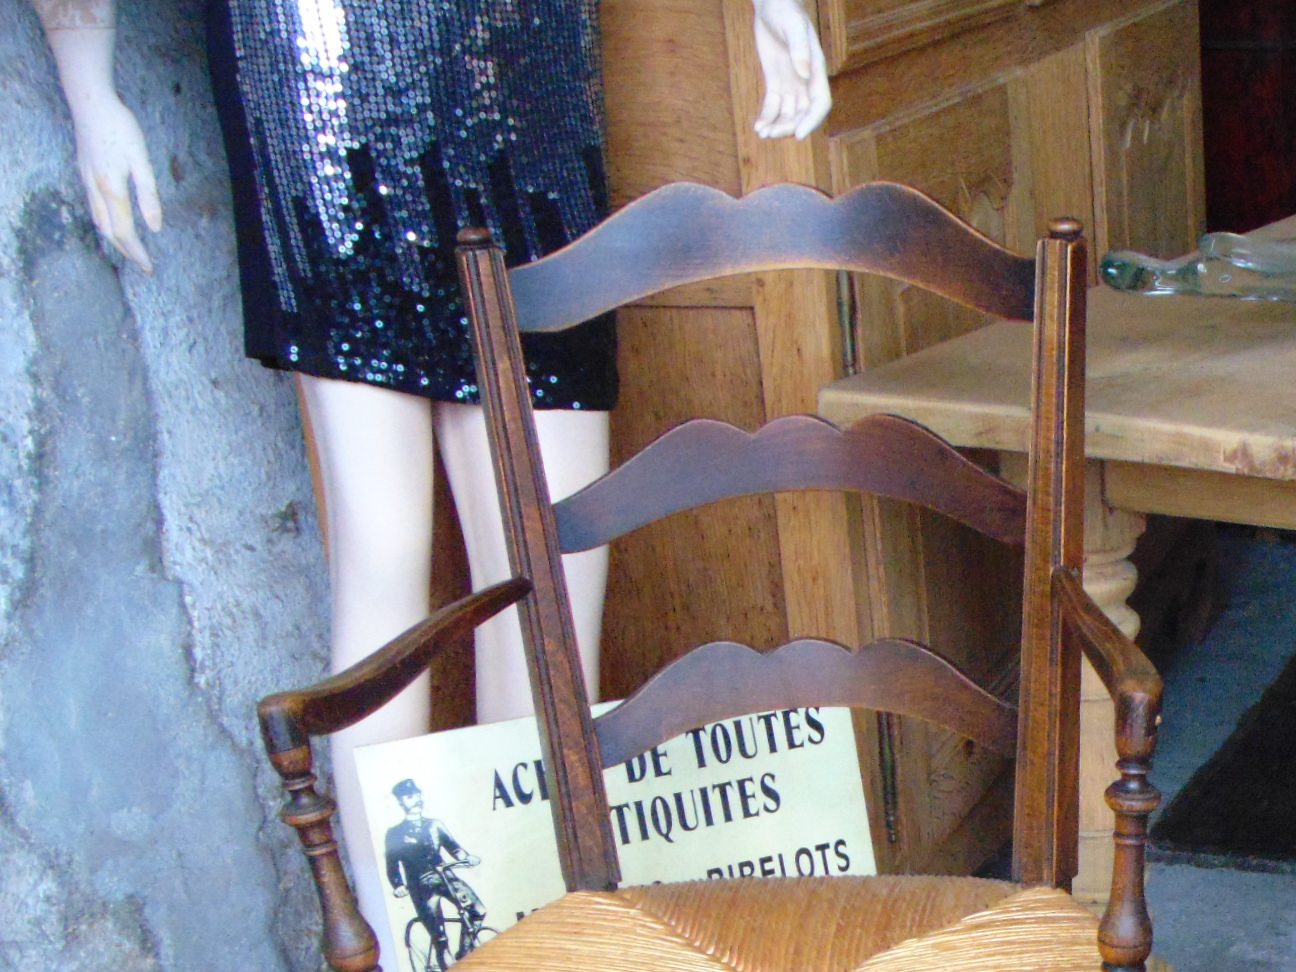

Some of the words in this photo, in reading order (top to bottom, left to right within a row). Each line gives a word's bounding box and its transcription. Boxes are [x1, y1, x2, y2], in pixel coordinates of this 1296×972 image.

[624, 745, 672, 783] DE
[685, 707, 825, 769] TOUTES
[609, 772, 782, 845] TIQUITES
